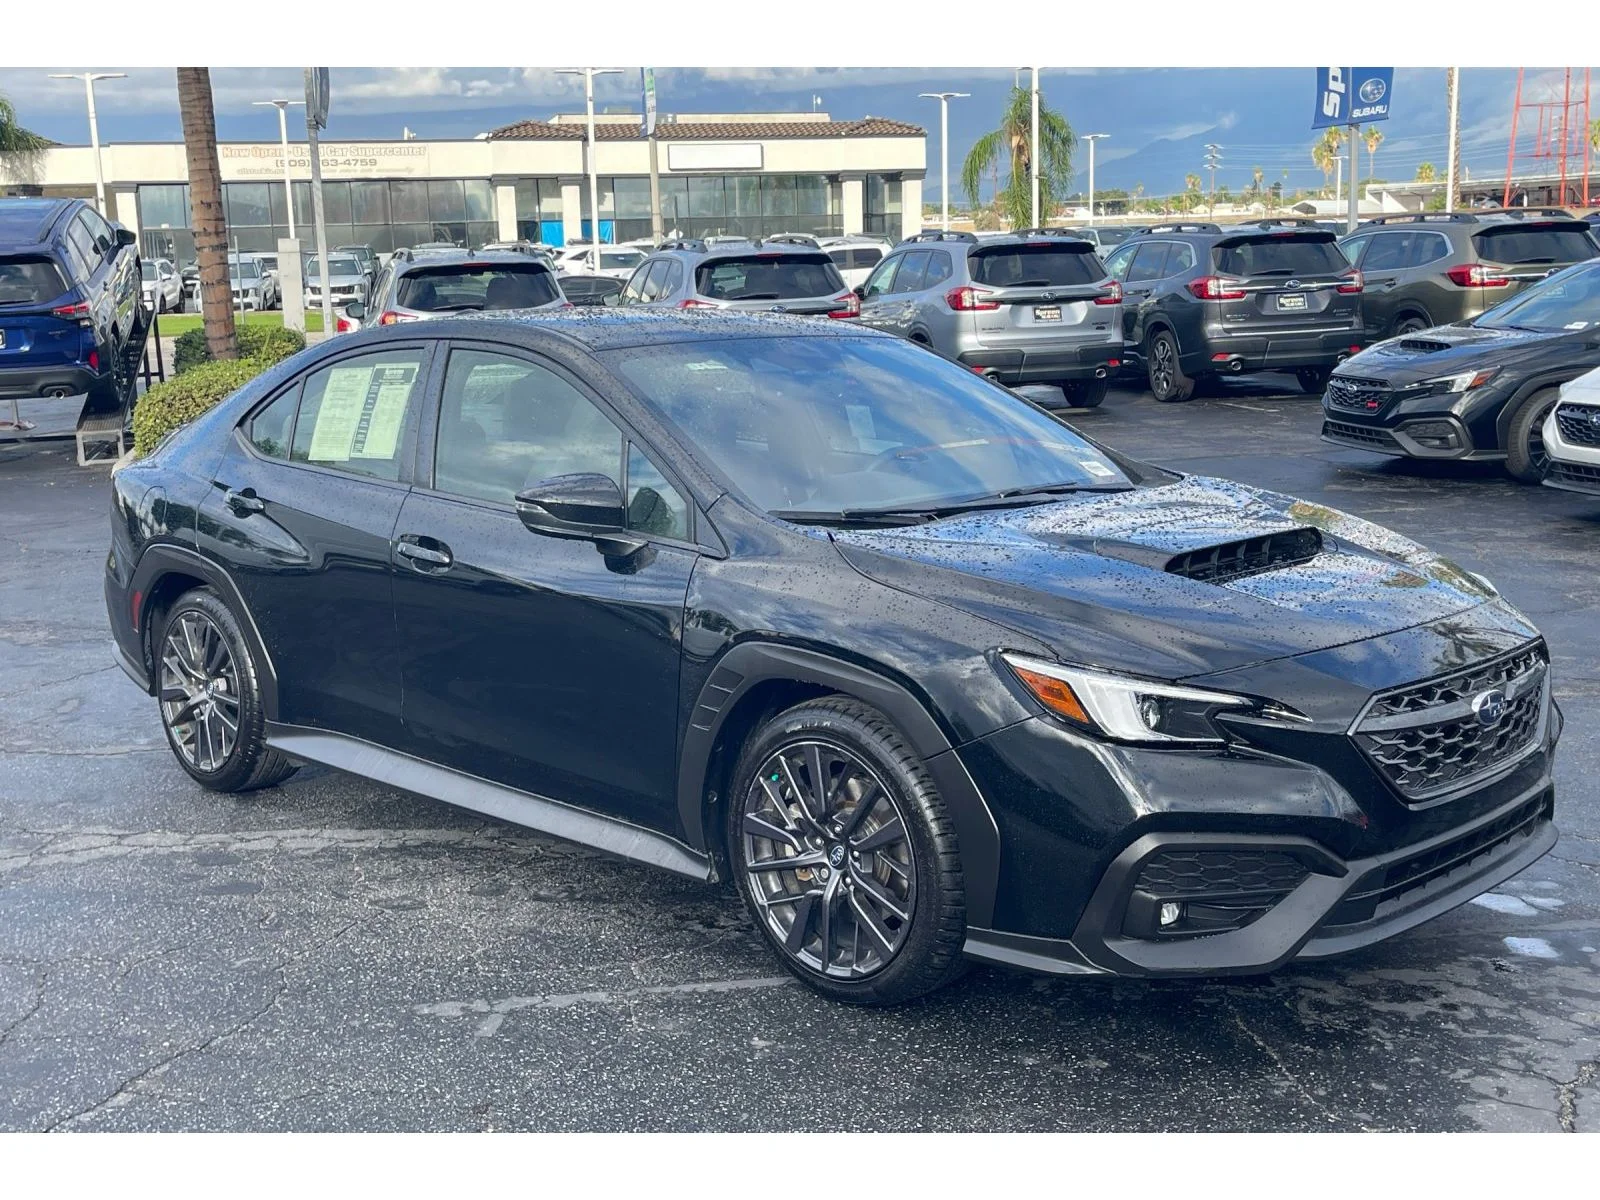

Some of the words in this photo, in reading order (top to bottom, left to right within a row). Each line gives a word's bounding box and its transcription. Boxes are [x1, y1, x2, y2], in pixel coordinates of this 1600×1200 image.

[1352, 105, 1387, 118] SUBARU
[222, 146, 250, 158] Now
[251, 146, 283, 158] Open
[293, 146, 326, 158] Usd
[326, 146, 348, 157] Car
[349, 146, 427, 157] Supercenter
[314, 158, 378, 167] 63-4759
